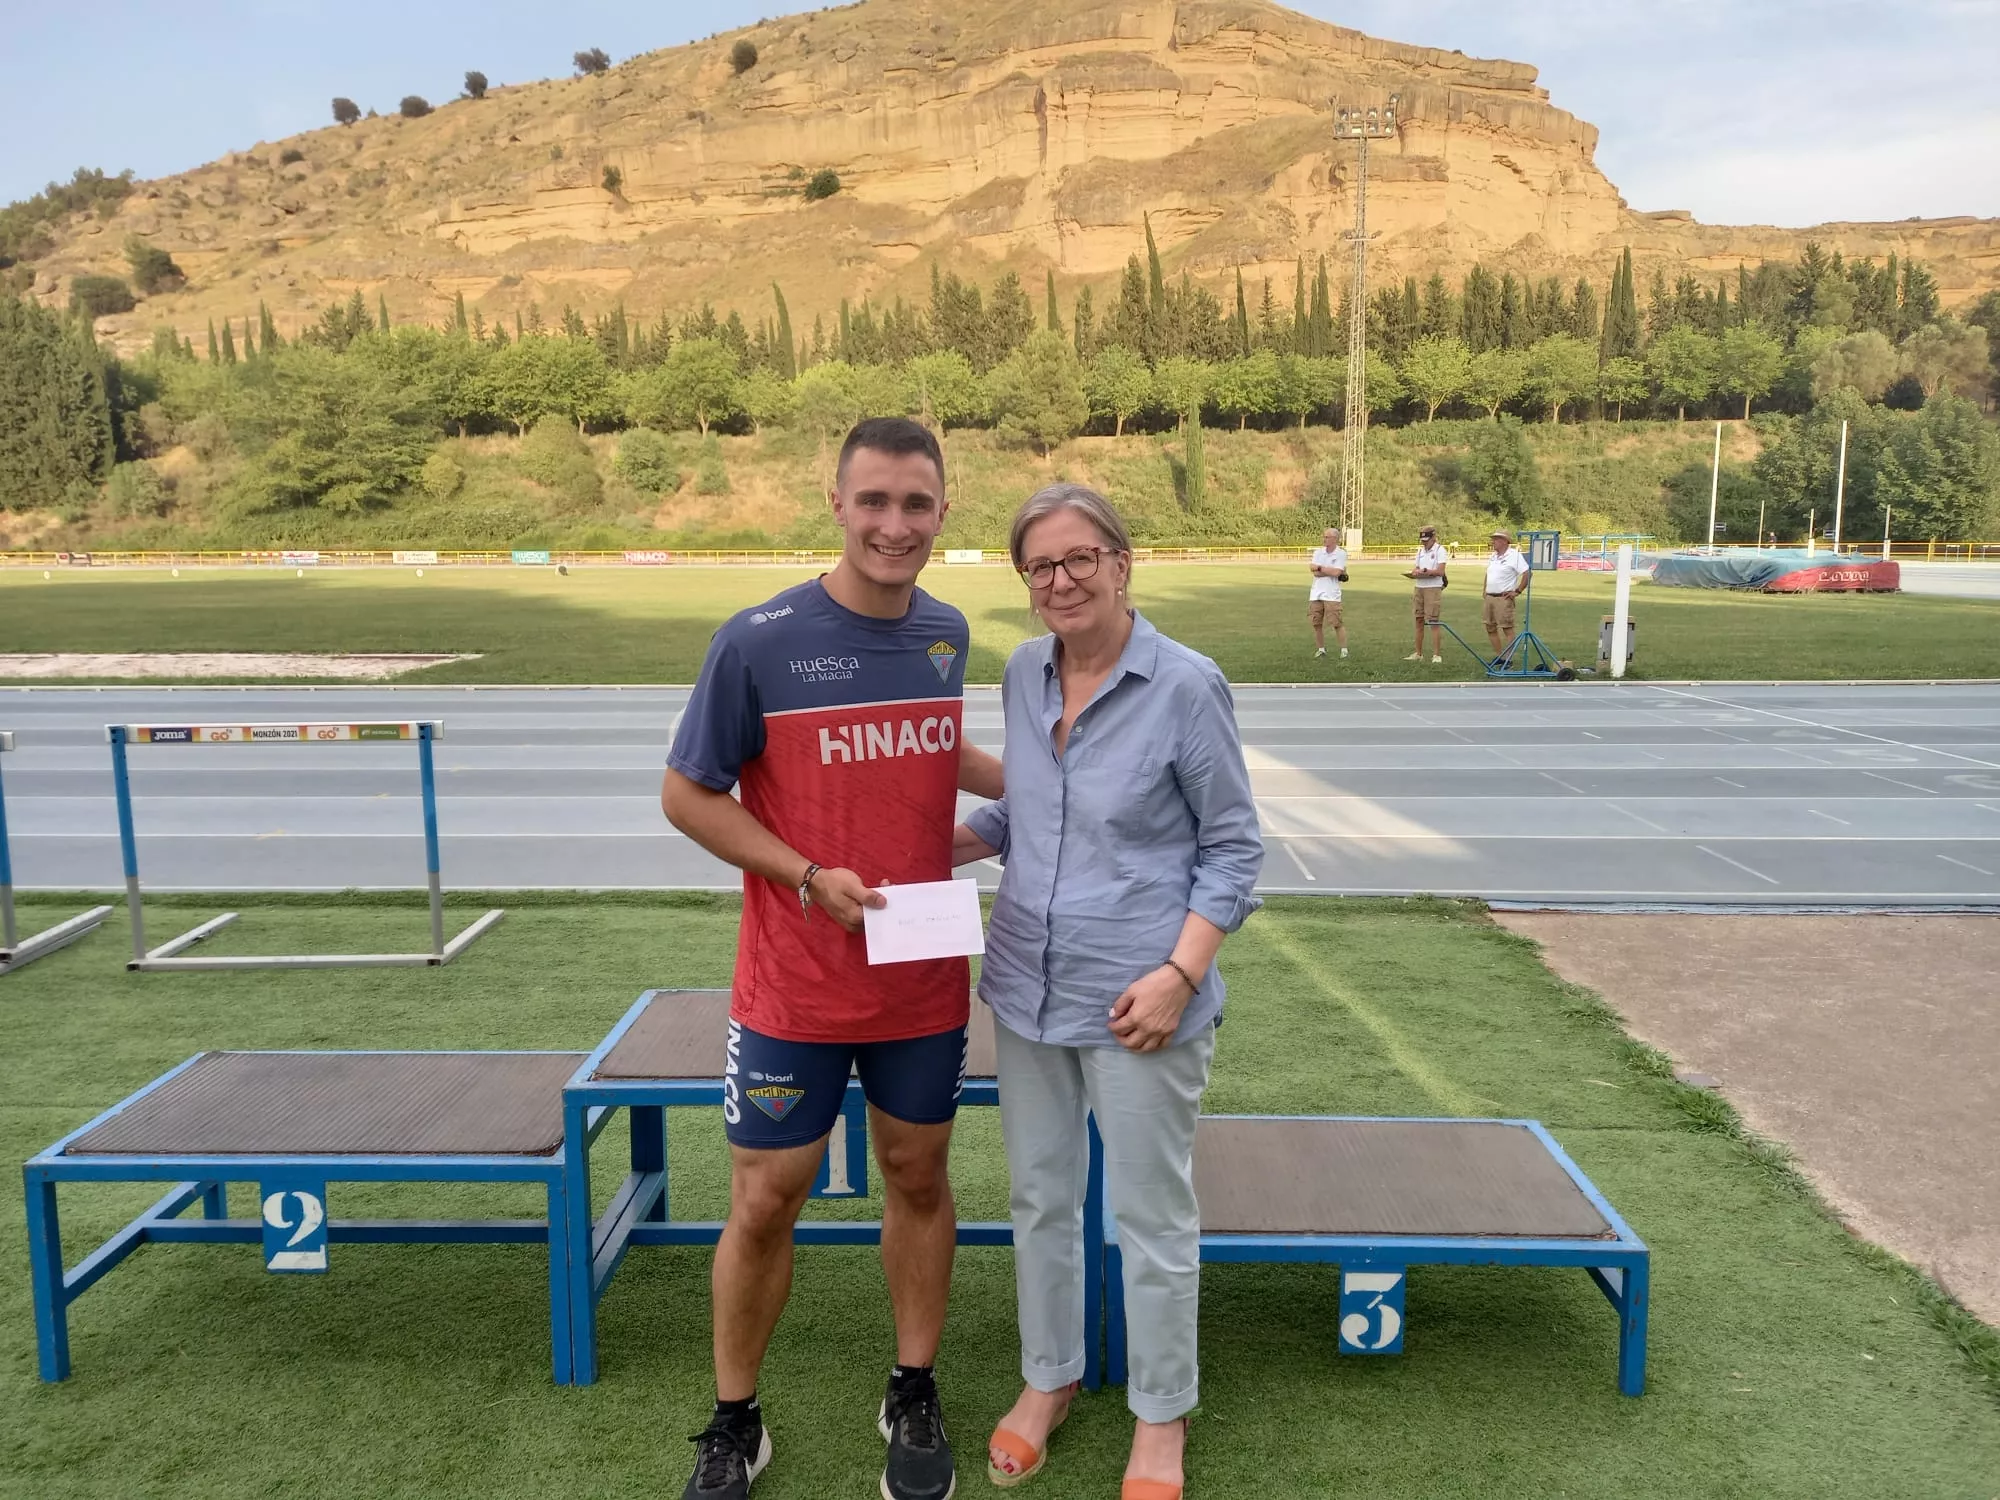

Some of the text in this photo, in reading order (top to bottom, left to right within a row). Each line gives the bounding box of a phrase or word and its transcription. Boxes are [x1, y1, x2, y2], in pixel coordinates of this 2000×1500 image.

[625, 551, 668, 562] HINACO
[1546, 540, 1553, 562] 1
[765, 605, 794, 620] barri
[210, 731, 230, 741] GO
[253, 729, 297, 738] MONZÓN 2021
[317, 729, 336, 739] GO
[818, 715, 955, 765] HINACO
[765, 1073, 793, 1082] barri
[821, 1113, 856, 1194] 1
[263, 1191, 327, 1270] 2
[1341, 1272, 1403, 1349] 3
